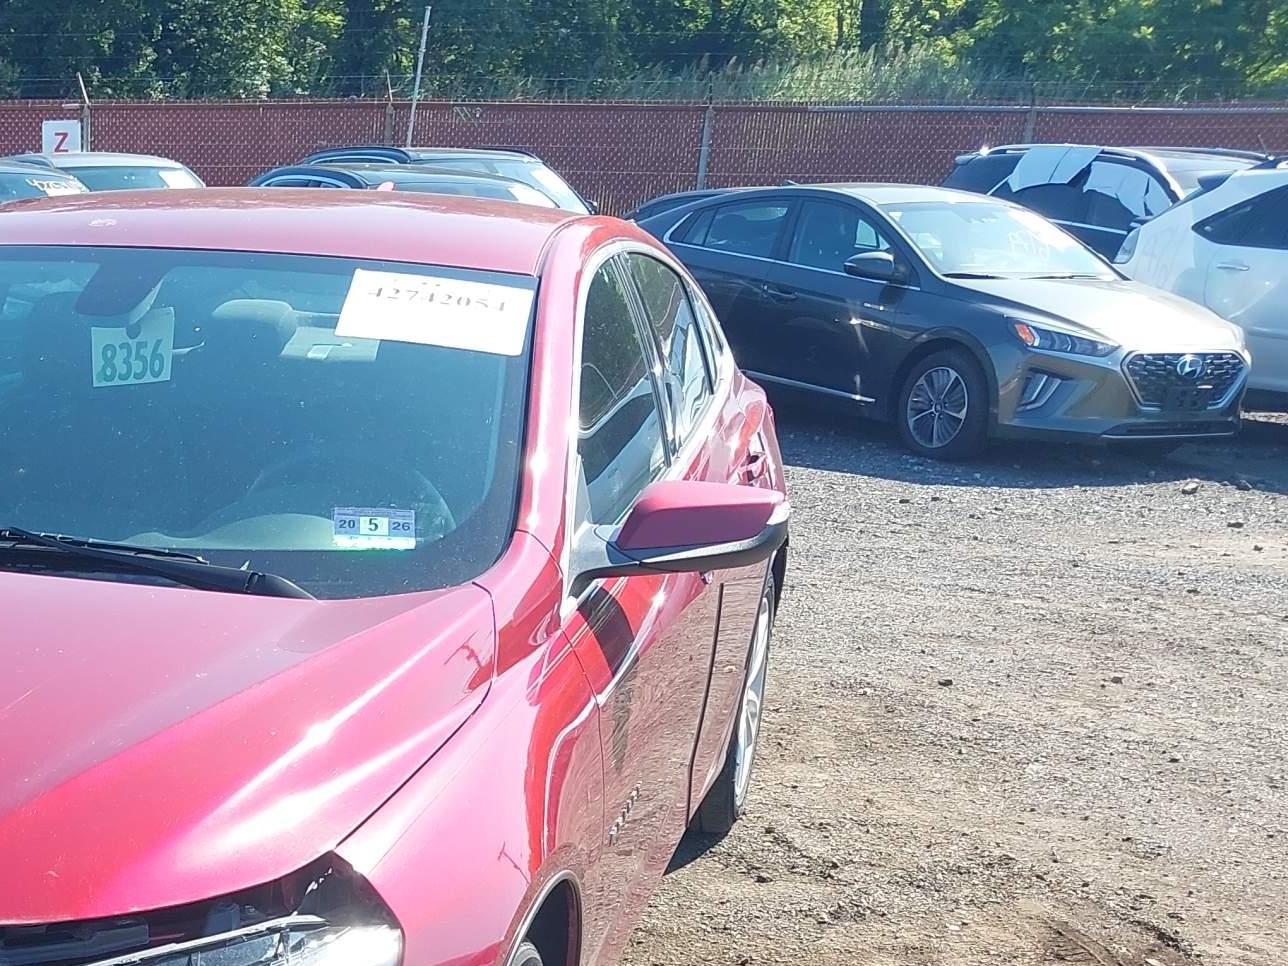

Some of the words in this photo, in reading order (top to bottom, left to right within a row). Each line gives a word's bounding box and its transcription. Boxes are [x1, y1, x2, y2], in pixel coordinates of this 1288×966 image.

[54, 132, 69, 153] Z
[367, 286, 506, 313] 42742054
[101, 339, 165, 383] 8356
[338, 519, 356, 529] 20
[367, 517, 379, 532] 5
[392, 521, 411, 532] 26
